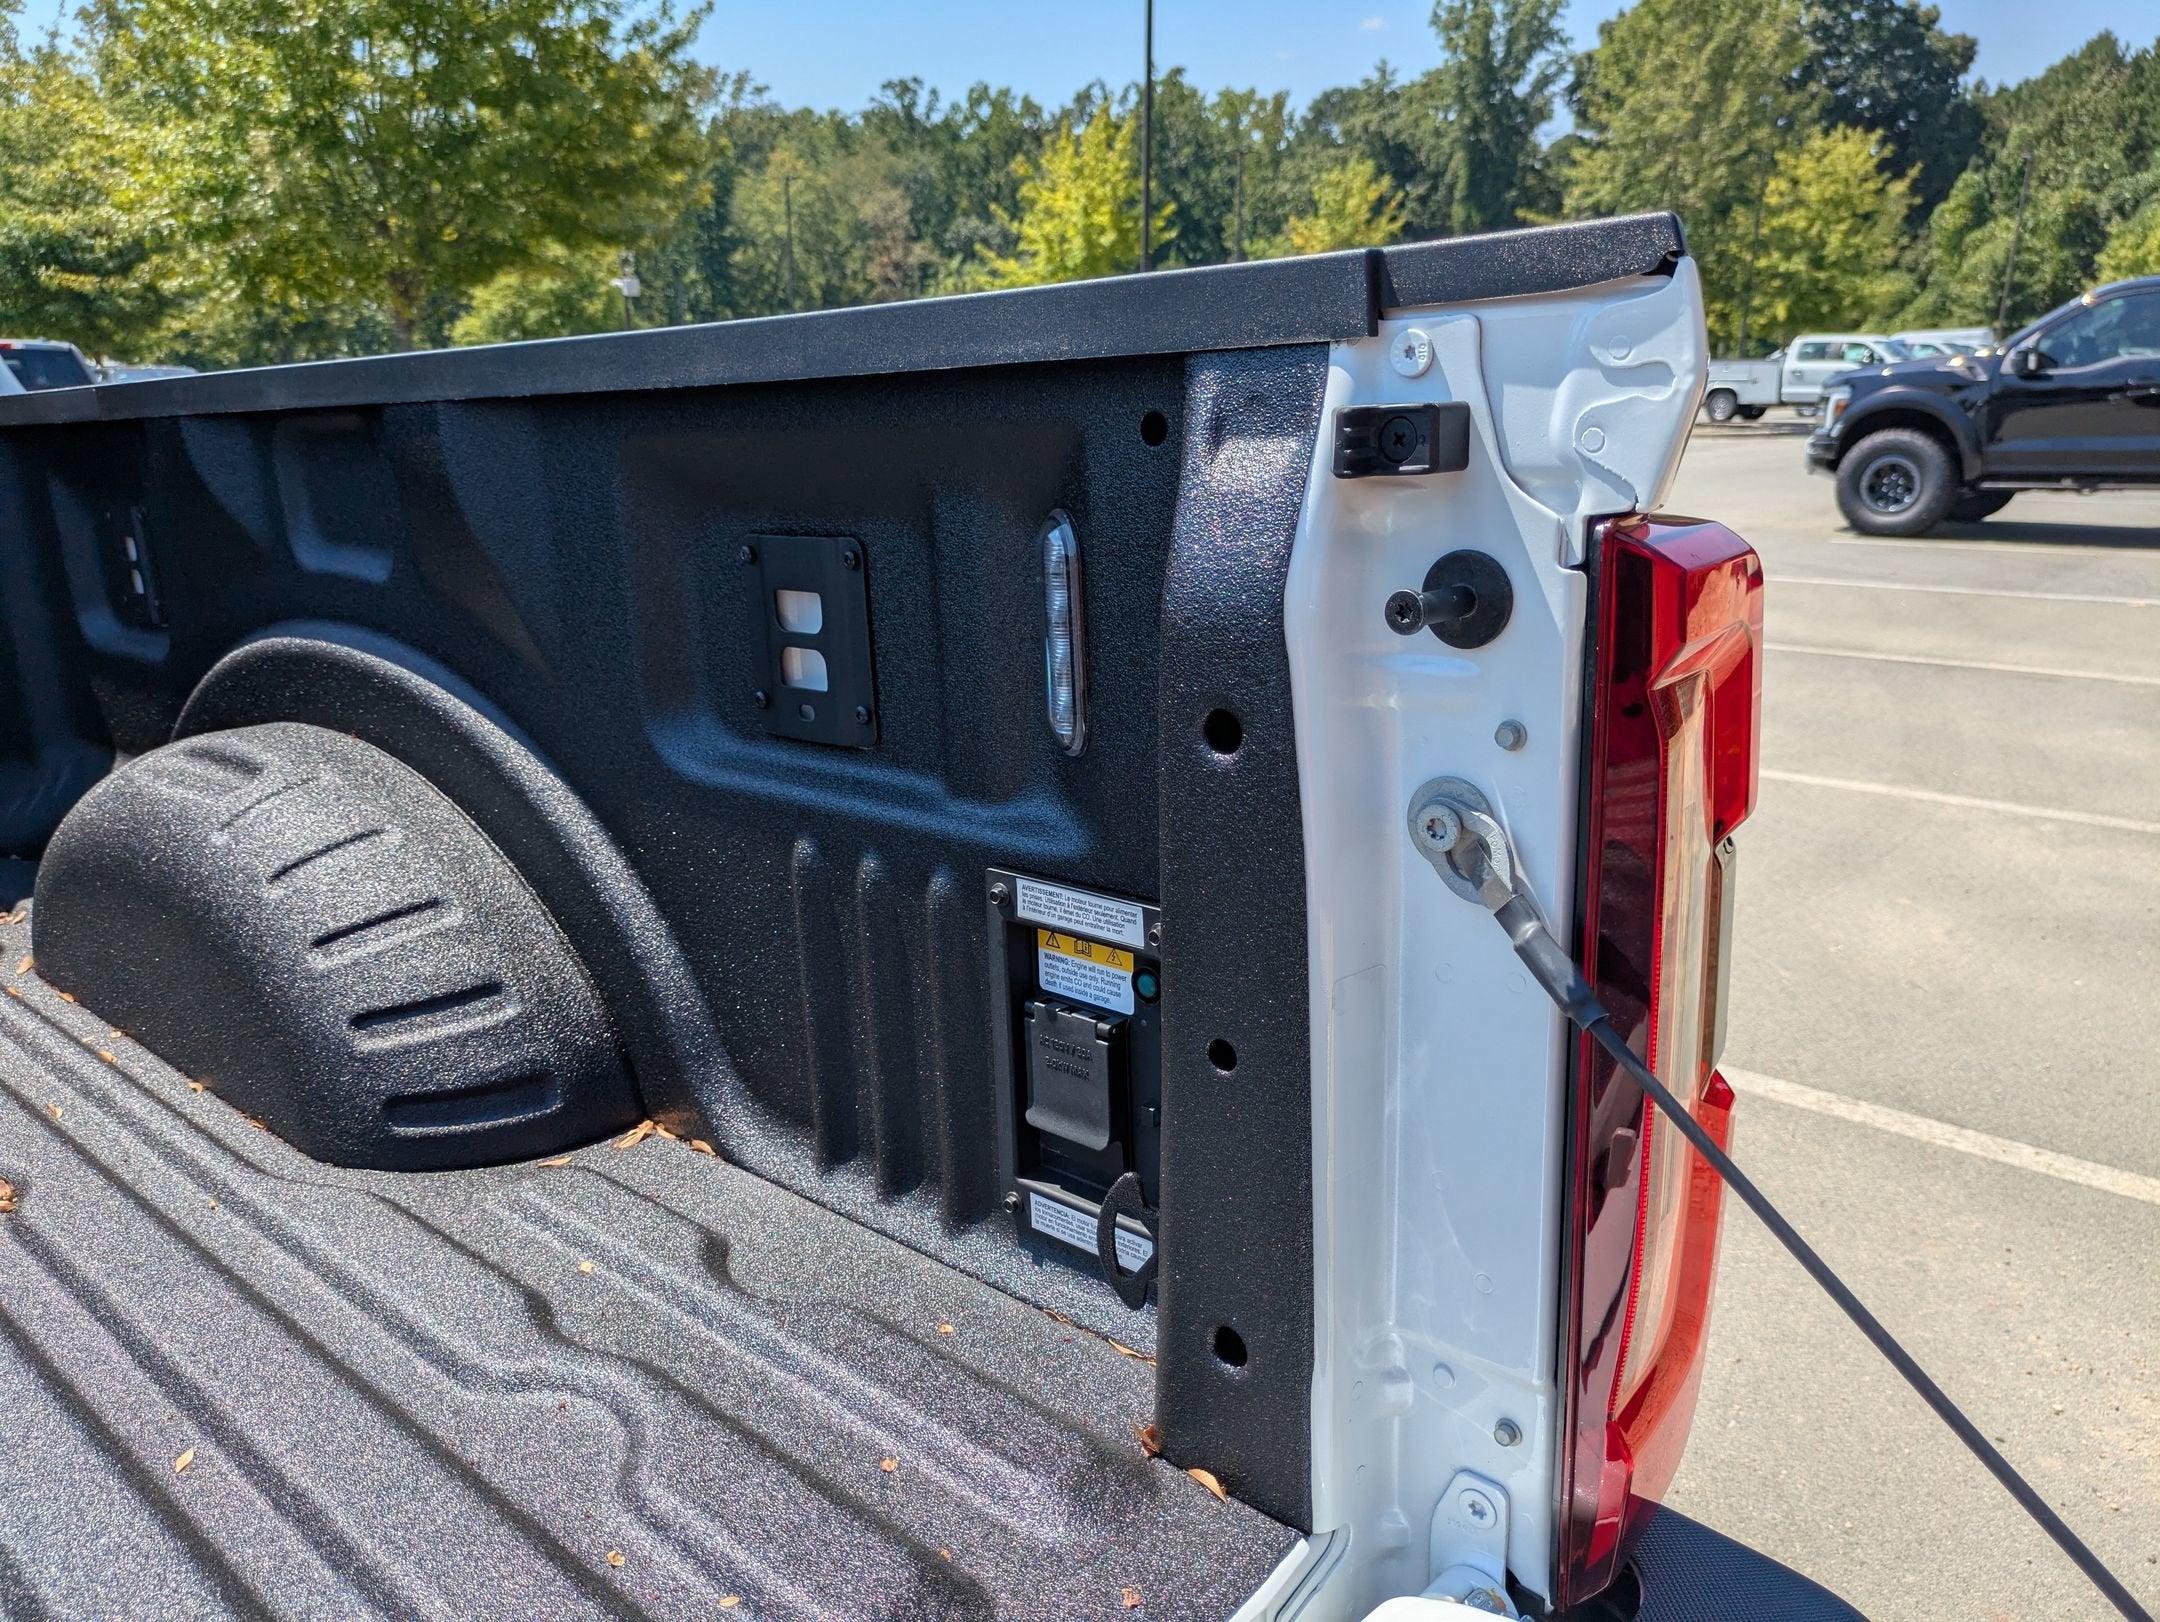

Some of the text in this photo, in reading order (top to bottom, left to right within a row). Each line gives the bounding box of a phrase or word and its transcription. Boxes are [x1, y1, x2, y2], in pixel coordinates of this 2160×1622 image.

[1488, 832, 1504, 872] FoMoC
[1022, 884, 1063, 899] AVERTISSEMENT:
[1071, 896, 1086, 905] moteur
[1088, 901, 1101, 909] tourne
[1057, 914, 1072, 923] garage
[1073, 918, 1083, 926] peut
[1103, 918, 1124, 929] utilisation
[1120, 915, 1136, 925] Quand
[1043, 952, 1070, 965] WARNING:
[1071, 959, 1087, 971] Engine
[1111, 972, 1126, 982] power
[1044, 970, 1121, 998] engine emits CO and could cause
[1044, 978, 1057, 987] death
[1062, 983, 1073, 992] used
[1074, 987, 1087, 996] inside
[1061, 966, 1078, 976] outside
[1100, 977, 1120, 990] Running
[1077, 1217, 1089, 1227] motor
